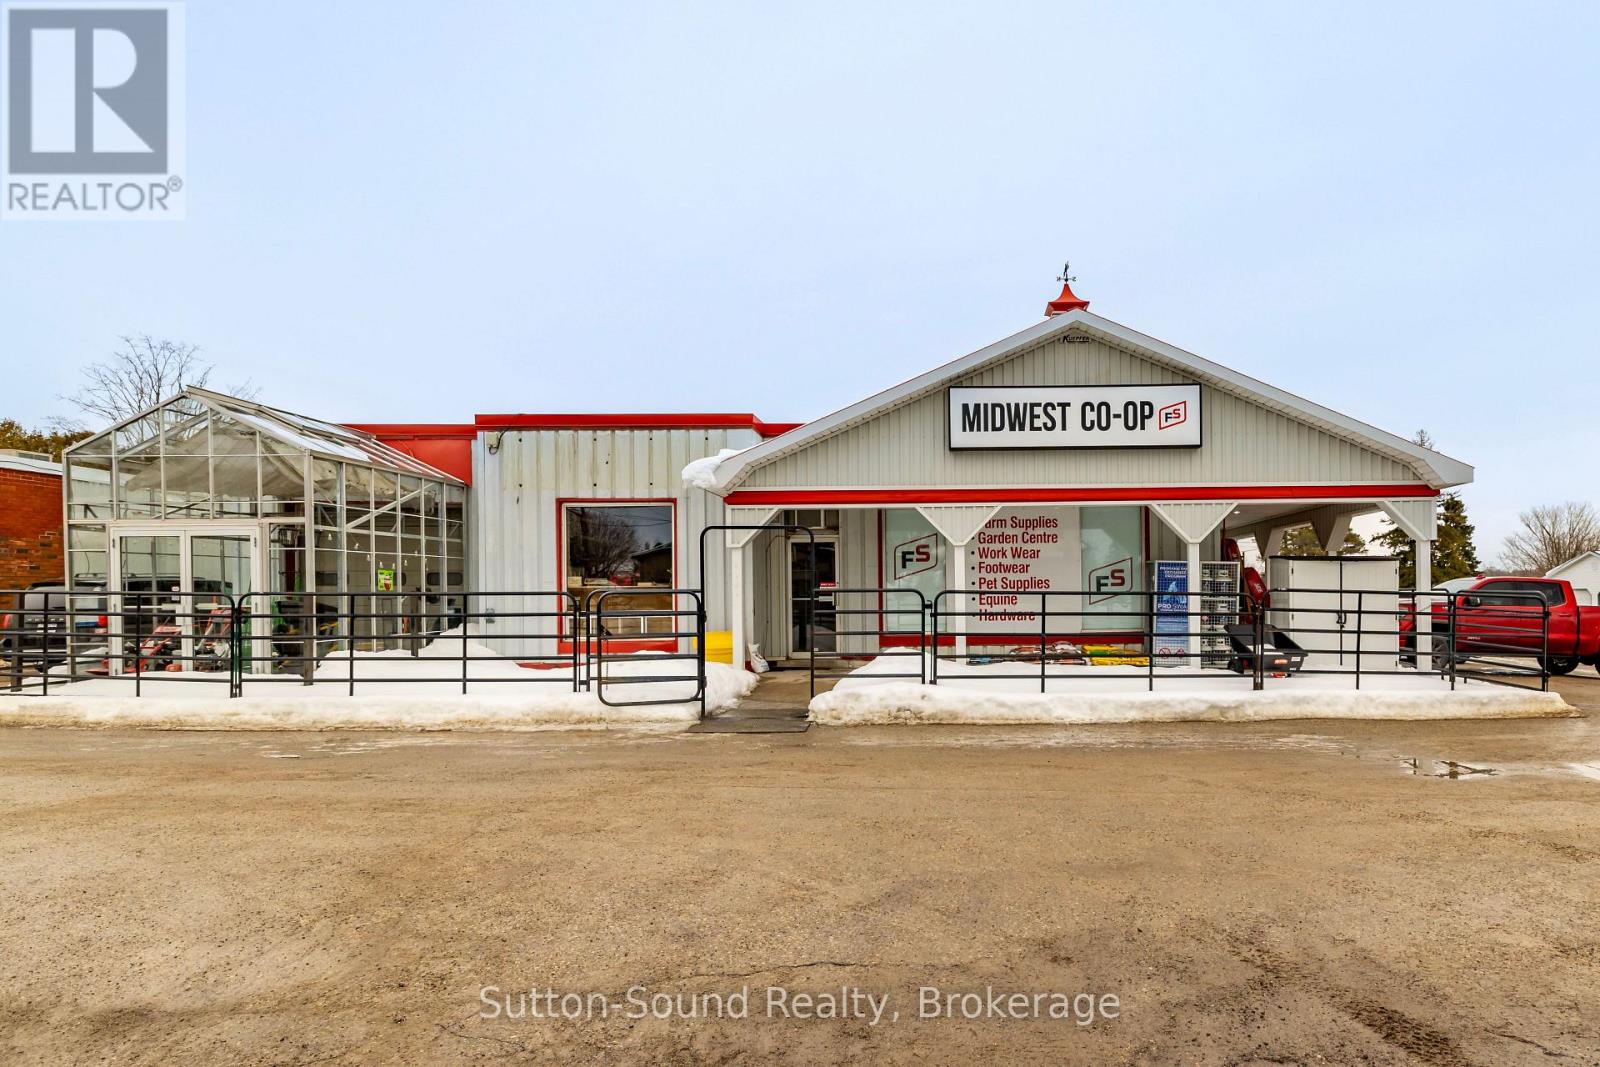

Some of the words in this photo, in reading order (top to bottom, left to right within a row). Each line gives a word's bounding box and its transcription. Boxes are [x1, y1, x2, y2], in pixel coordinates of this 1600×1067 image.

[961, 402, 1071, 432] MIDWEST
[1080, 400, 1154, 431] CO-OP
[1164, 408, 1181, 423] FS
[984, 518, 1007, 529] arm
[1010, 515, 1058, 531] Supplies
[978, 531, 1018, 544] Garden
[1021, 531, 1058, 544] Centre
[901, 544, 931, 569] FS
[978, 546, 1008, 559] Work
[1010, 546, 1041, 559] Wear
[978, 561, 1031, 574] Footwear
[978, 576, 998, 590] Pet
[1000, 576, 1050, 592] Supplies
[1095, 568, 1126, 592] FS
[978, 592, 1018, 608] Equine
[979, 608, 1036, 622] Hardware
